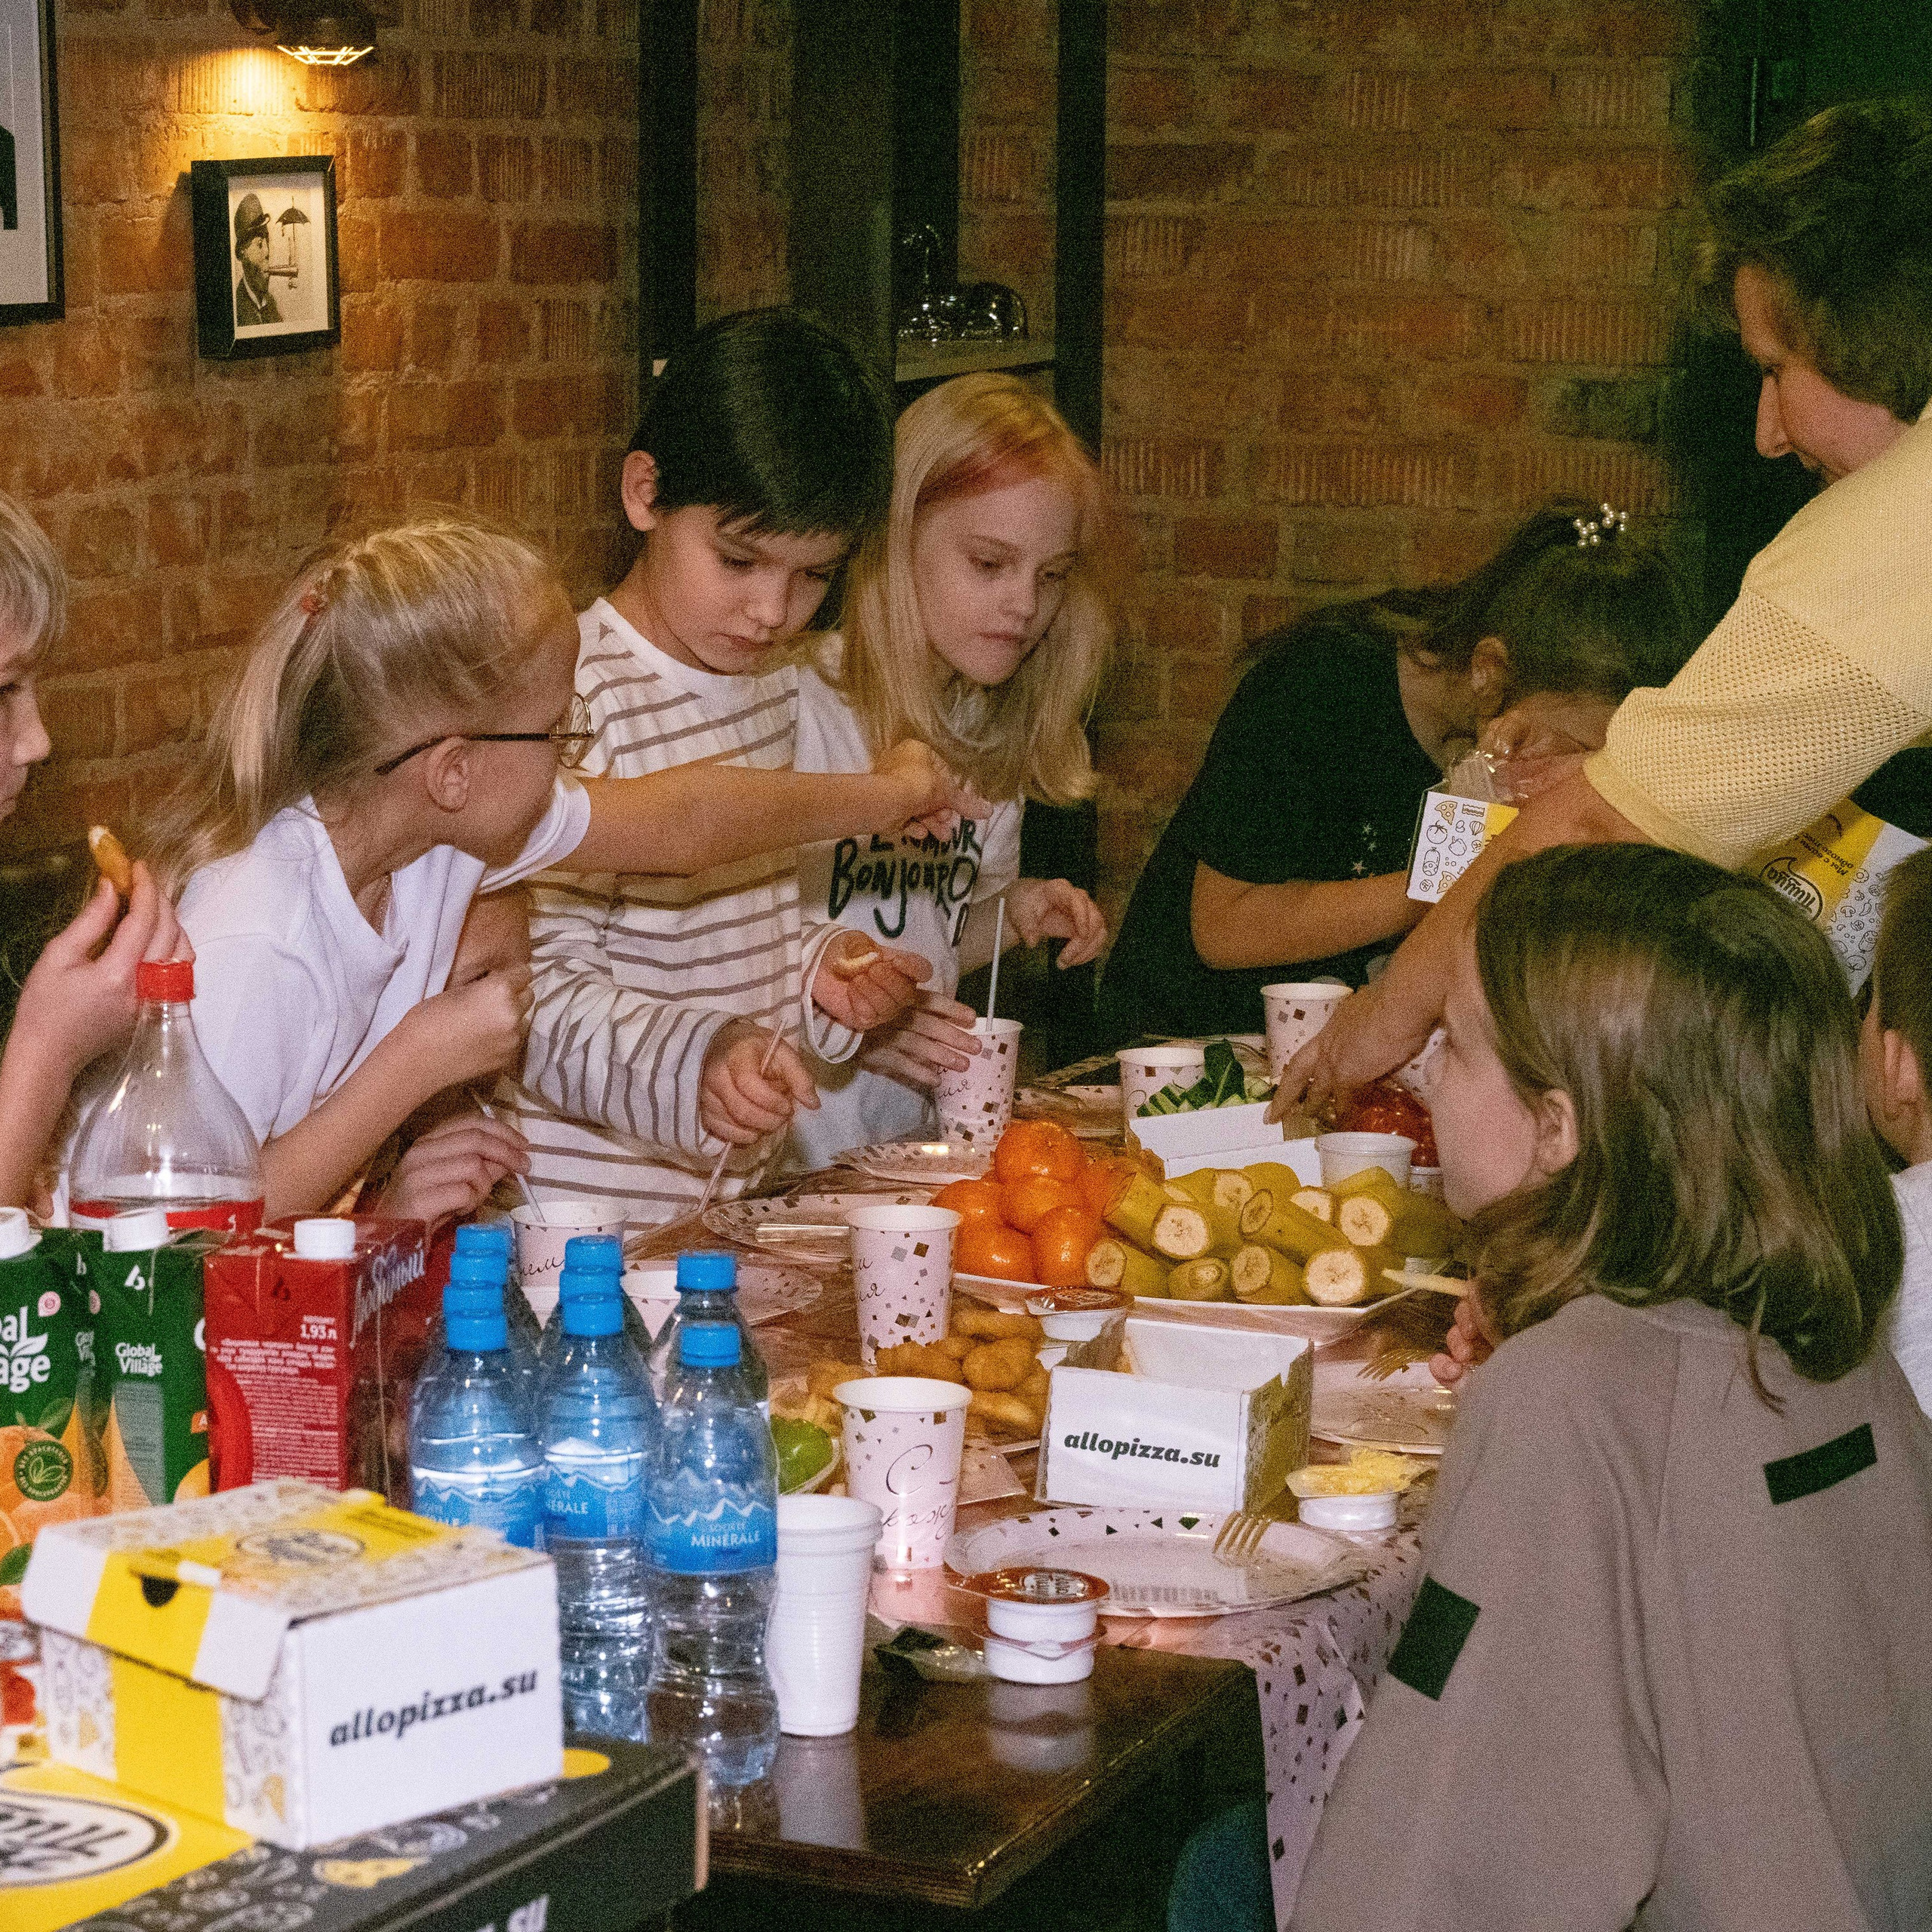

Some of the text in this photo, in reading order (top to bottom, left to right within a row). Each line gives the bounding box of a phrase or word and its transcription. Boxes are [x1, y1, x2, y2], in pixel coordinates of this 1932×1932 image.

[115, 1342, 155, 1358] Global
[119, 1356, 164, 1378] Village
[1063, 1431, 1221, 1468] allopizza.su
[329, 1668, 538, 1747] allopizza.su
